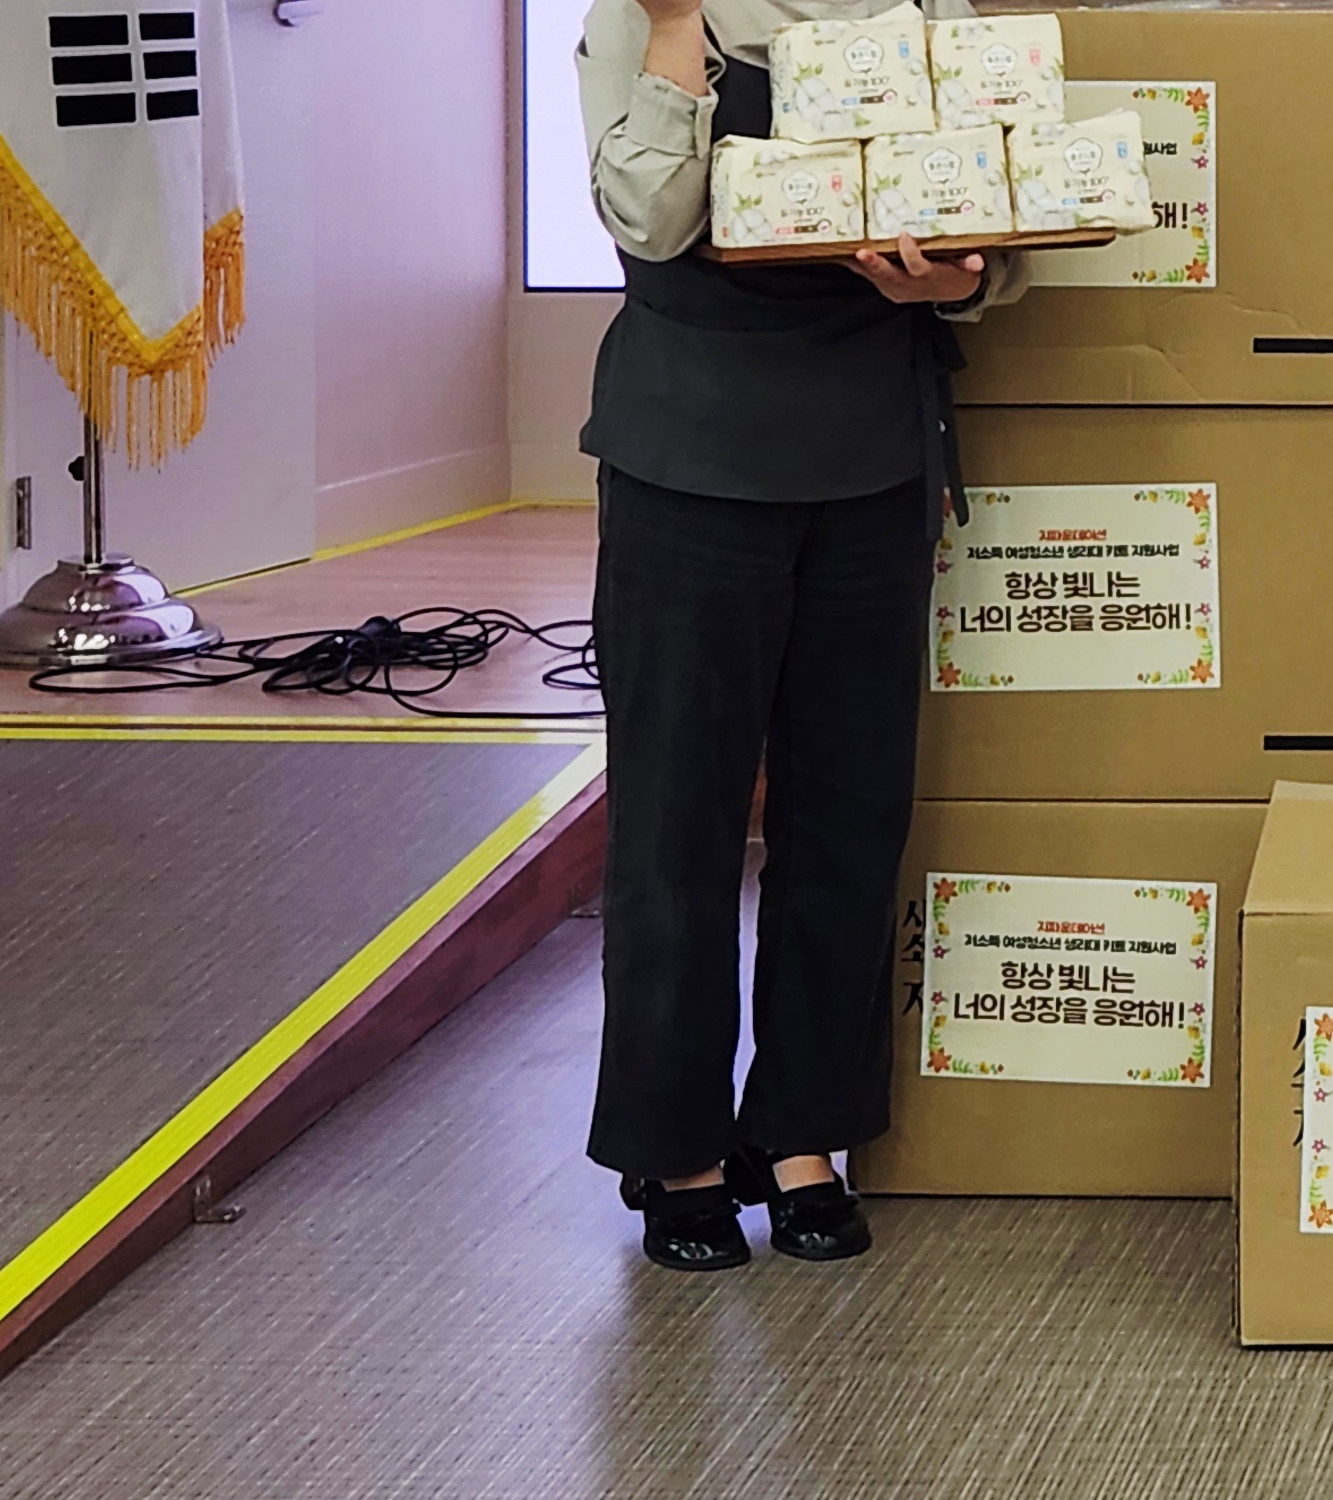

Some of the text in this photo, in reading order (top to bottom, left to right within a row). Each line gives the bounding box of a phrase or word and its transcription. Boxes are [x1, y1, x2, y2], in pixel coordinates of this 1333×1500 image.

[1004, 570, 1141, 601] 항상 빛나는
[959, 602, 1192, 634] 너의 성장을 응원해!
[1000, 960, 1136, 994] 항상 빛나는
[953, 992, 1185, 1030] 너의 성장을 응원해!
